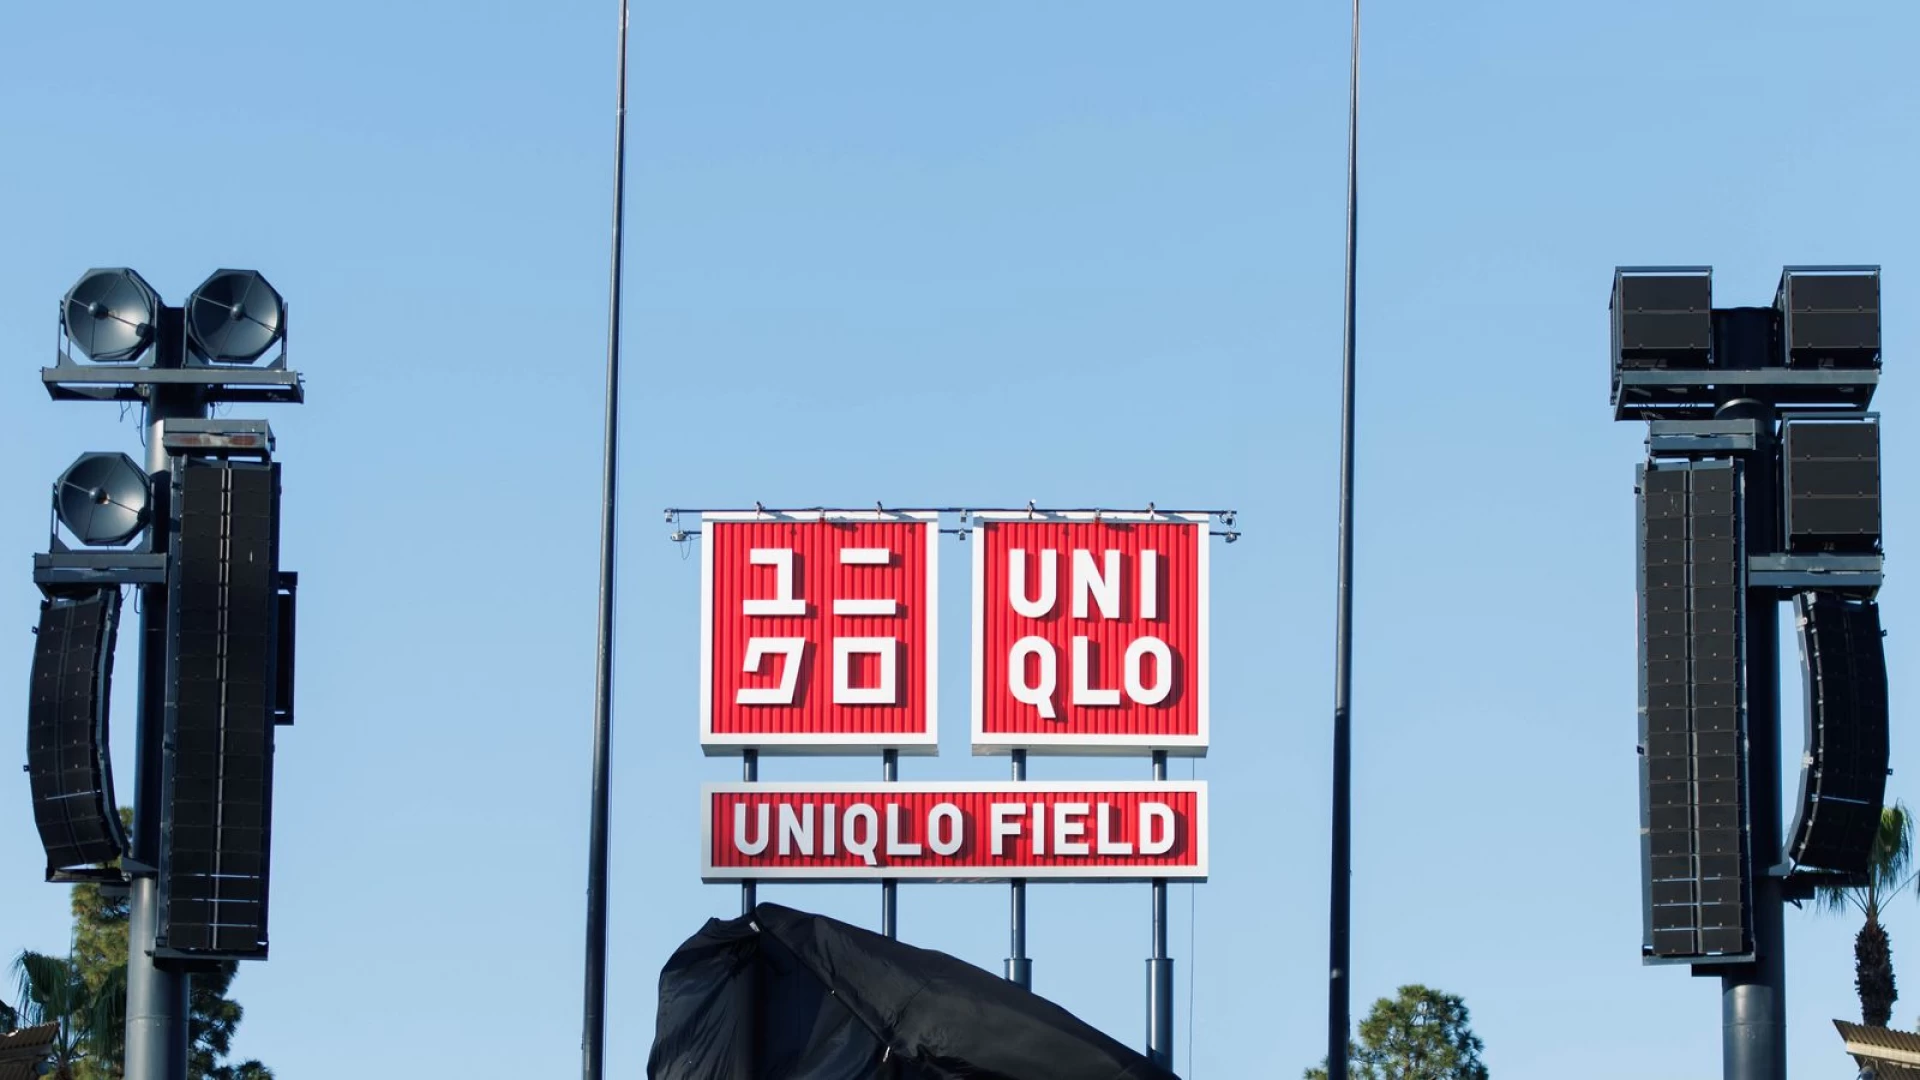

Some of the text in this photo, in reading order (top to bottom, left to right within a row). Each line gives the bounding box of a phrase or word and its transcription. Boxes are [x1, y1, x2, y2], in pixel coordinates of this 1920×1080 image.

[742, 547, 898, 616] ユニ
[1008, 548, 1157, 619] UNI
[735, 636, 897, 704] クロ
[1008, 635, 1172, 718] QLO
[734, 801, 1175, 866] UNIQLO FIELD
